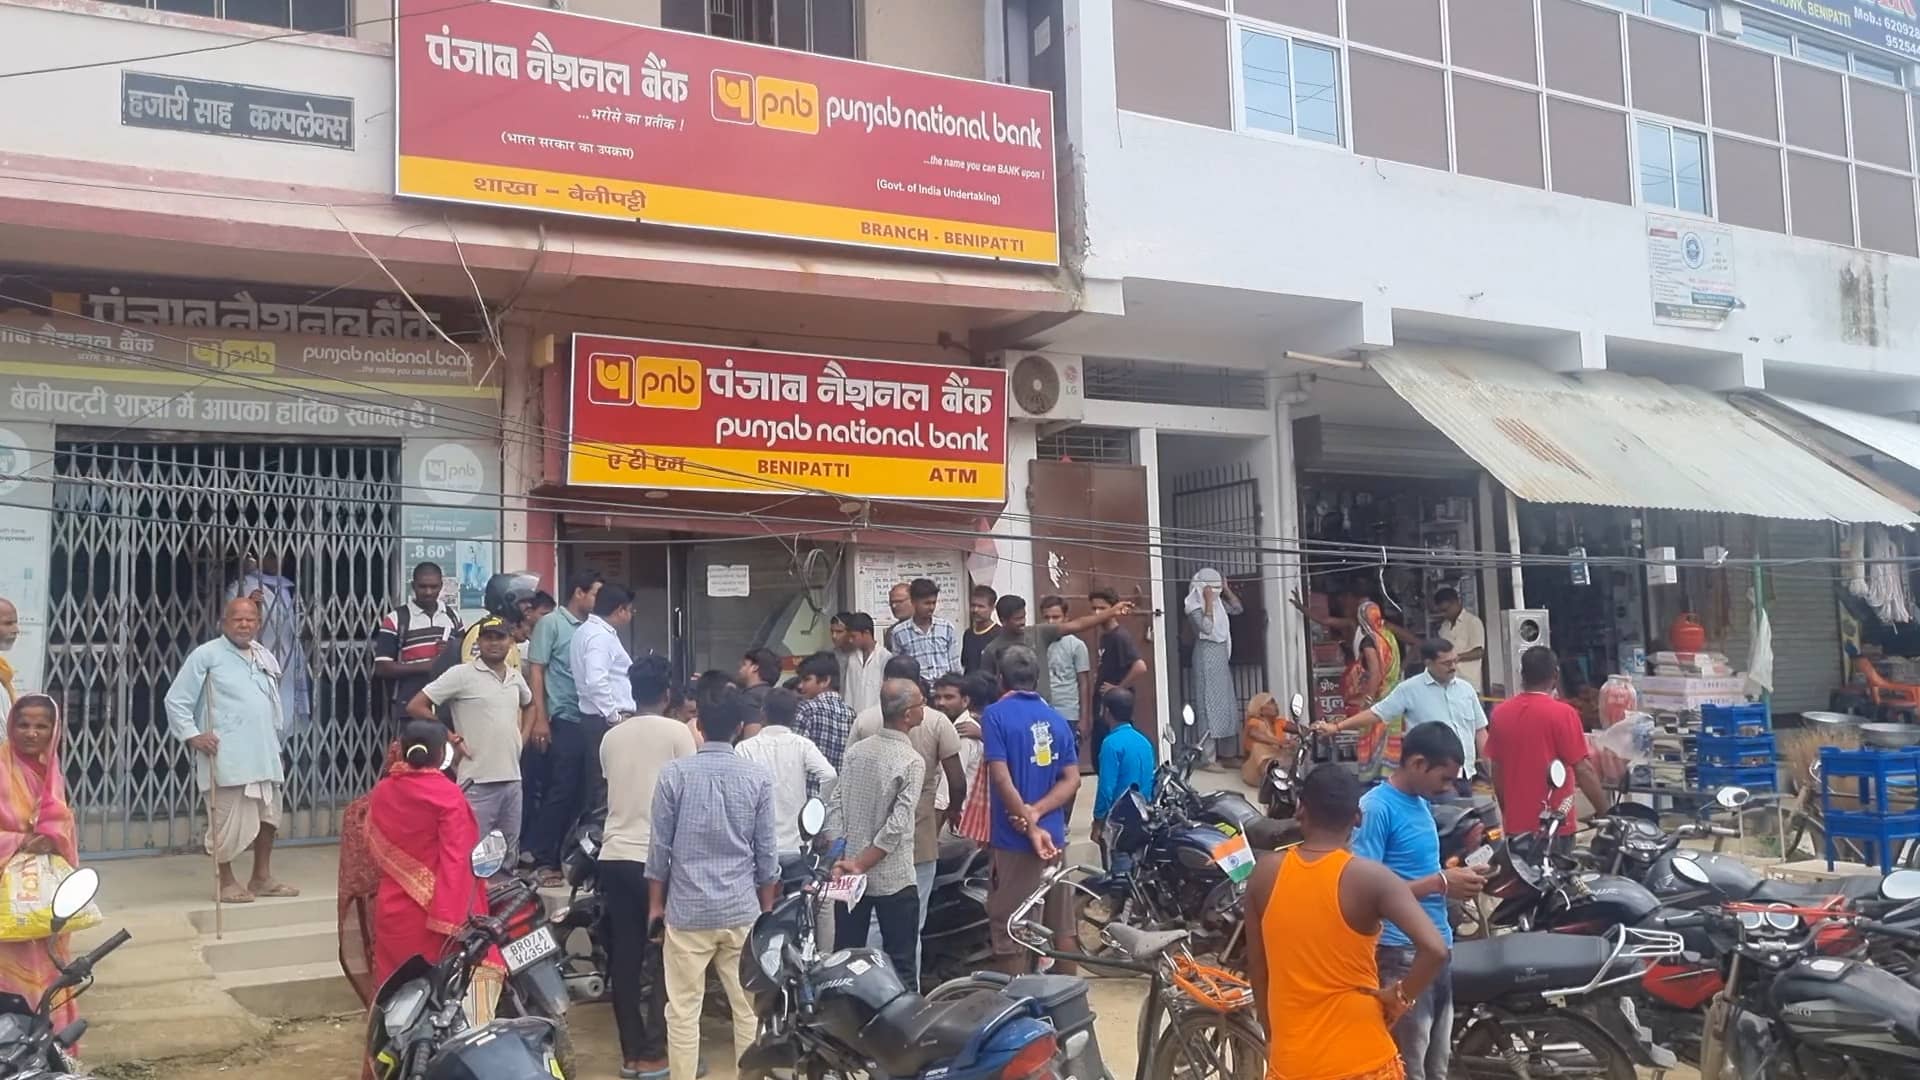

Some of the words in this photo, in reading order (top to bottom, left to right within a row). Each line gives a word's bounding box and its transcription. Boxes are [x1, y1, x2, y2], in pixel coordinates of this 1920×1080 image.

[1807, 2, 1852, 28] BENIPATTI
[425, 24, 519, 81] पंजाब
[526, 31, 631, 96] नैशनल
[641, 51, 688, 103] बैंक
[128, 85, 190, 121] हजारी
[193, 98, 234, 129] साह
[761, 88, 813, 121] pnb
[624, 113, 641, 126] का
[644, 114, 677, 130] प्रतीक
[826, 95, 901, 133] punjab
[904, 104, 990, 142] national
[993, 112, 1043, 149] bank
[501, 131, 535, 146] (भारत
[538, 137, 575, 152] सरकार
[578, 142, 594, 153] का
[944, 159, 966, 169] name
[966, 161, 981, 172] you
[982, 163, 997, 173] can
[997, 164, 1020, 177] BANK
[1021, 170, 1040, 180] upon
[473, 177, 538, 196] शाखा
[876, 178, 905, 191] (Govt.
[907, 184, 917, 193] of
[919, 184, 941, 197] India
[943, 187, 1001, 206] Undertaking)
[860, 221, 929, 243] BRANCH
[944, 231, 1025, 252] BENIPATTI
[303, 346, 362, 365] punjab
[363, 347, 432, 366] national
[436, 350, 474, 367] bank
[640, 365, 696, 400] pnb
[706, 358, 808, 403] पंजाब
[816, 360, 930, 411] नैशनल
[941, 371, 993, 415] बैंक
[114, 393, 171, 418] शाखा
[175, 391, 195, 420] में
[201, 400, 269, 423] आपका
[715, 415, 812, 449] punjab
[816, 418, 922, 449] national
[928, 420, 990, 452] bank
[608, 454, 621, 470] ए
[628, 448, 647, 471] टी
[654, 455, 687, 473] एम
[757, 458, 850, 478] BENIPATTI
[929, 468, 978, 485] ATM
[510, 930, 545, 956] BR07A
